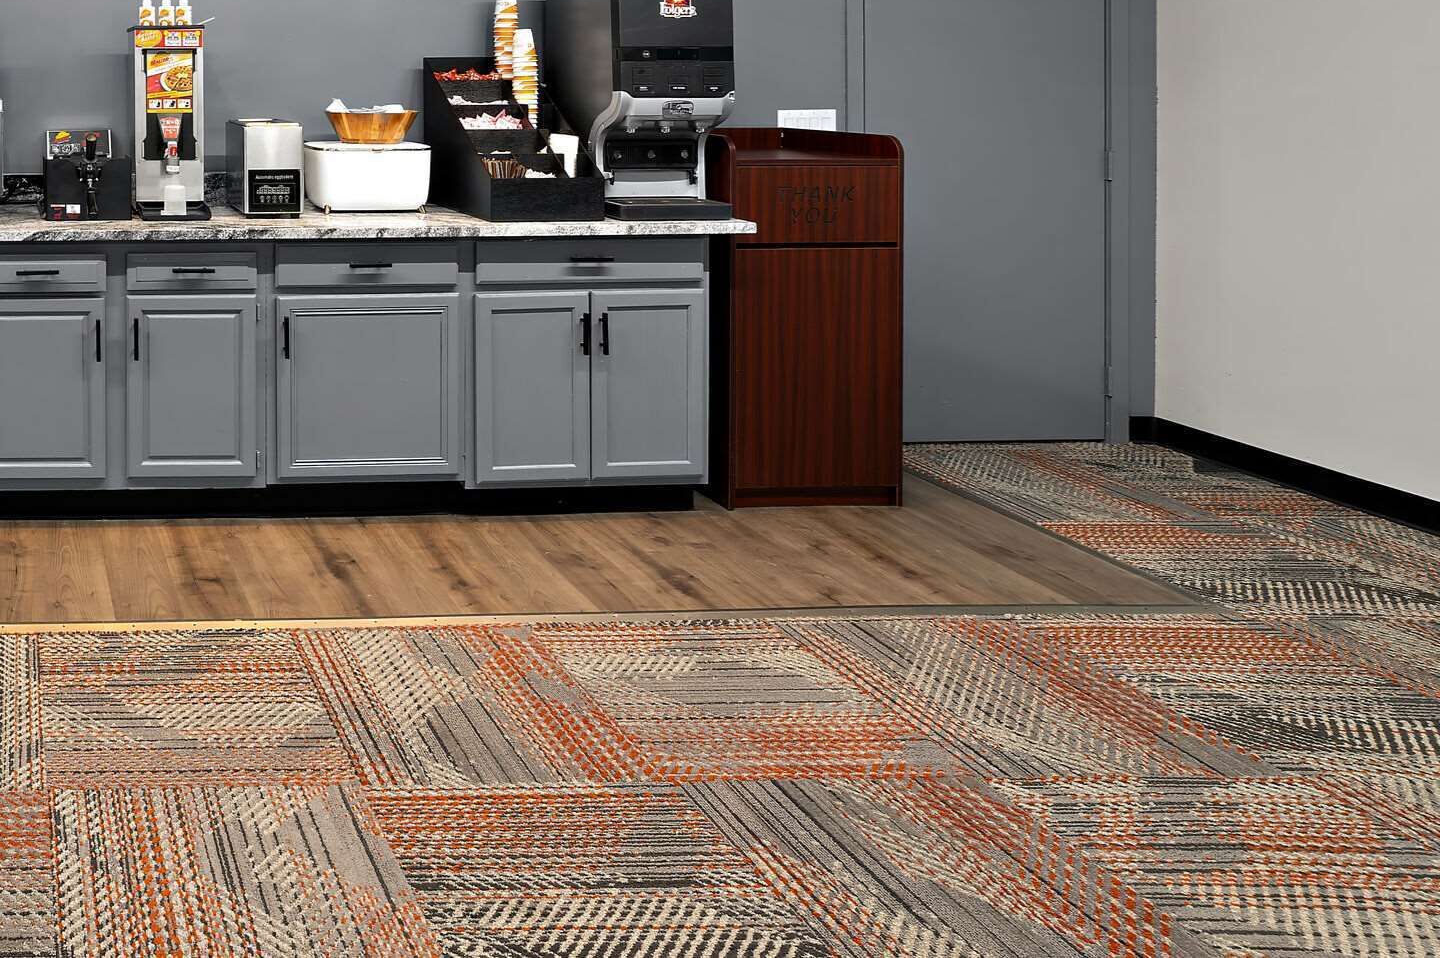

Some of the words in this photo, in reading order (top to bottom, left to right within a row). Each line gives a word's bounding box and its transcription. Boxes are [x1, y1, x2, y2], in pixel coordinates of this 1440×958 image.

[659, 1, 697, 19] Folgers
[776, 185, 857, 203] THANK
[790, 207, 840, 225] YOU
